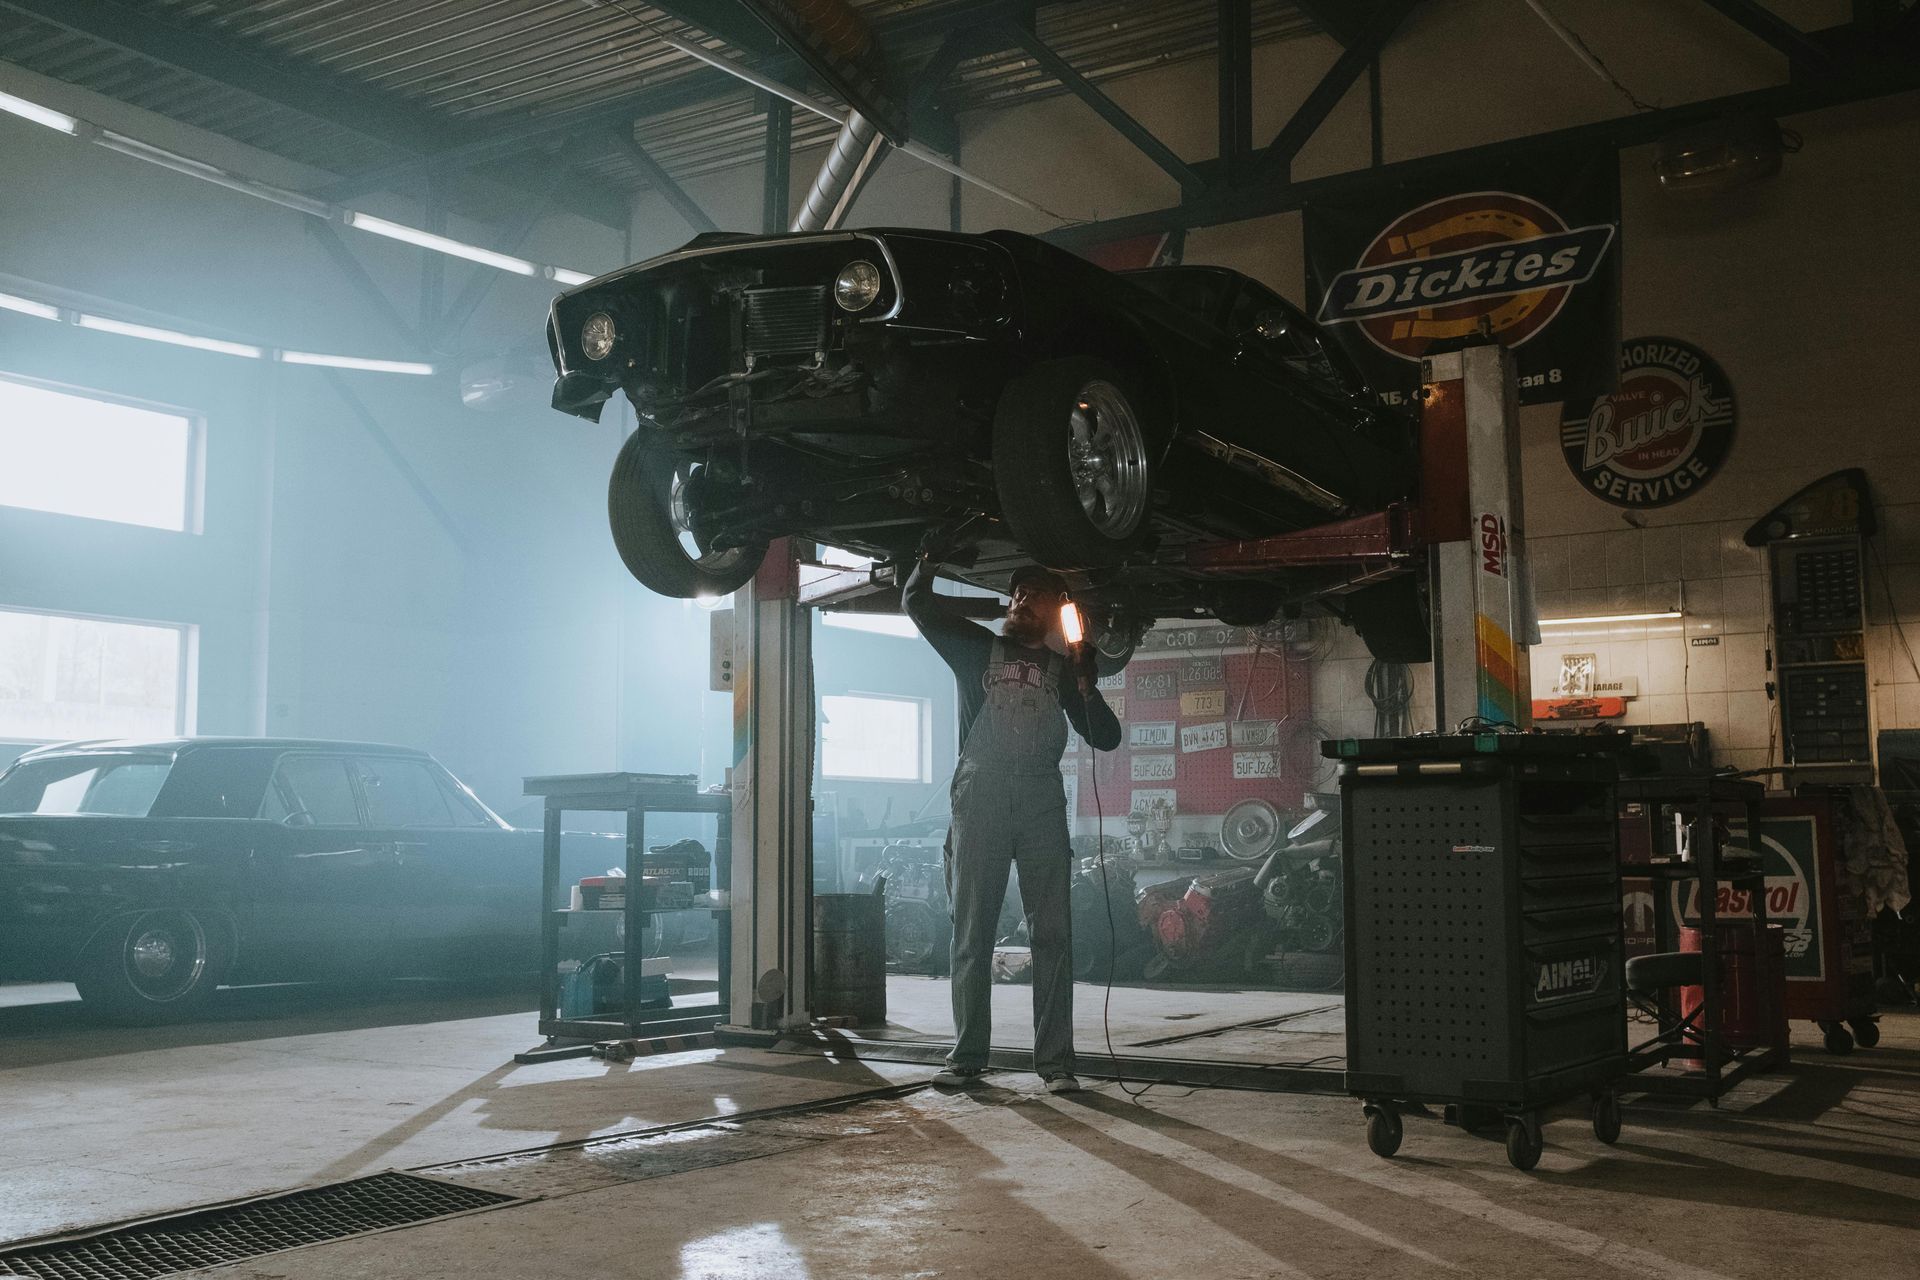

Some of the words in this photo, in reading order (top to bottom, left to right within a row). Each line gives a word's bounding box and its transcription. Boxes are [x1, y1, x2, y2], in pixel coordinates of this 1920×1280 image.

[1343, 246, 1582, 311] Dickies
[1548, 368, 1562, 383] 8
[1611, 390, 1648, 403] VALVE
[1583, 373, 1721, 471] Buick
[1638, 452, 1650, 461] IN
[1651, 448, 1681, 458] HEAD
[1593, 456, 1709, 502] SERVICE
[1481, 513, 1502, 576] MSD
[1194, 696, 1213, 710] 773
[1184, 733, 1199, 747] BVN
[1134, 764, 1173, 777] 5UFJ266
[1694, 882, 1800, 914] asol
